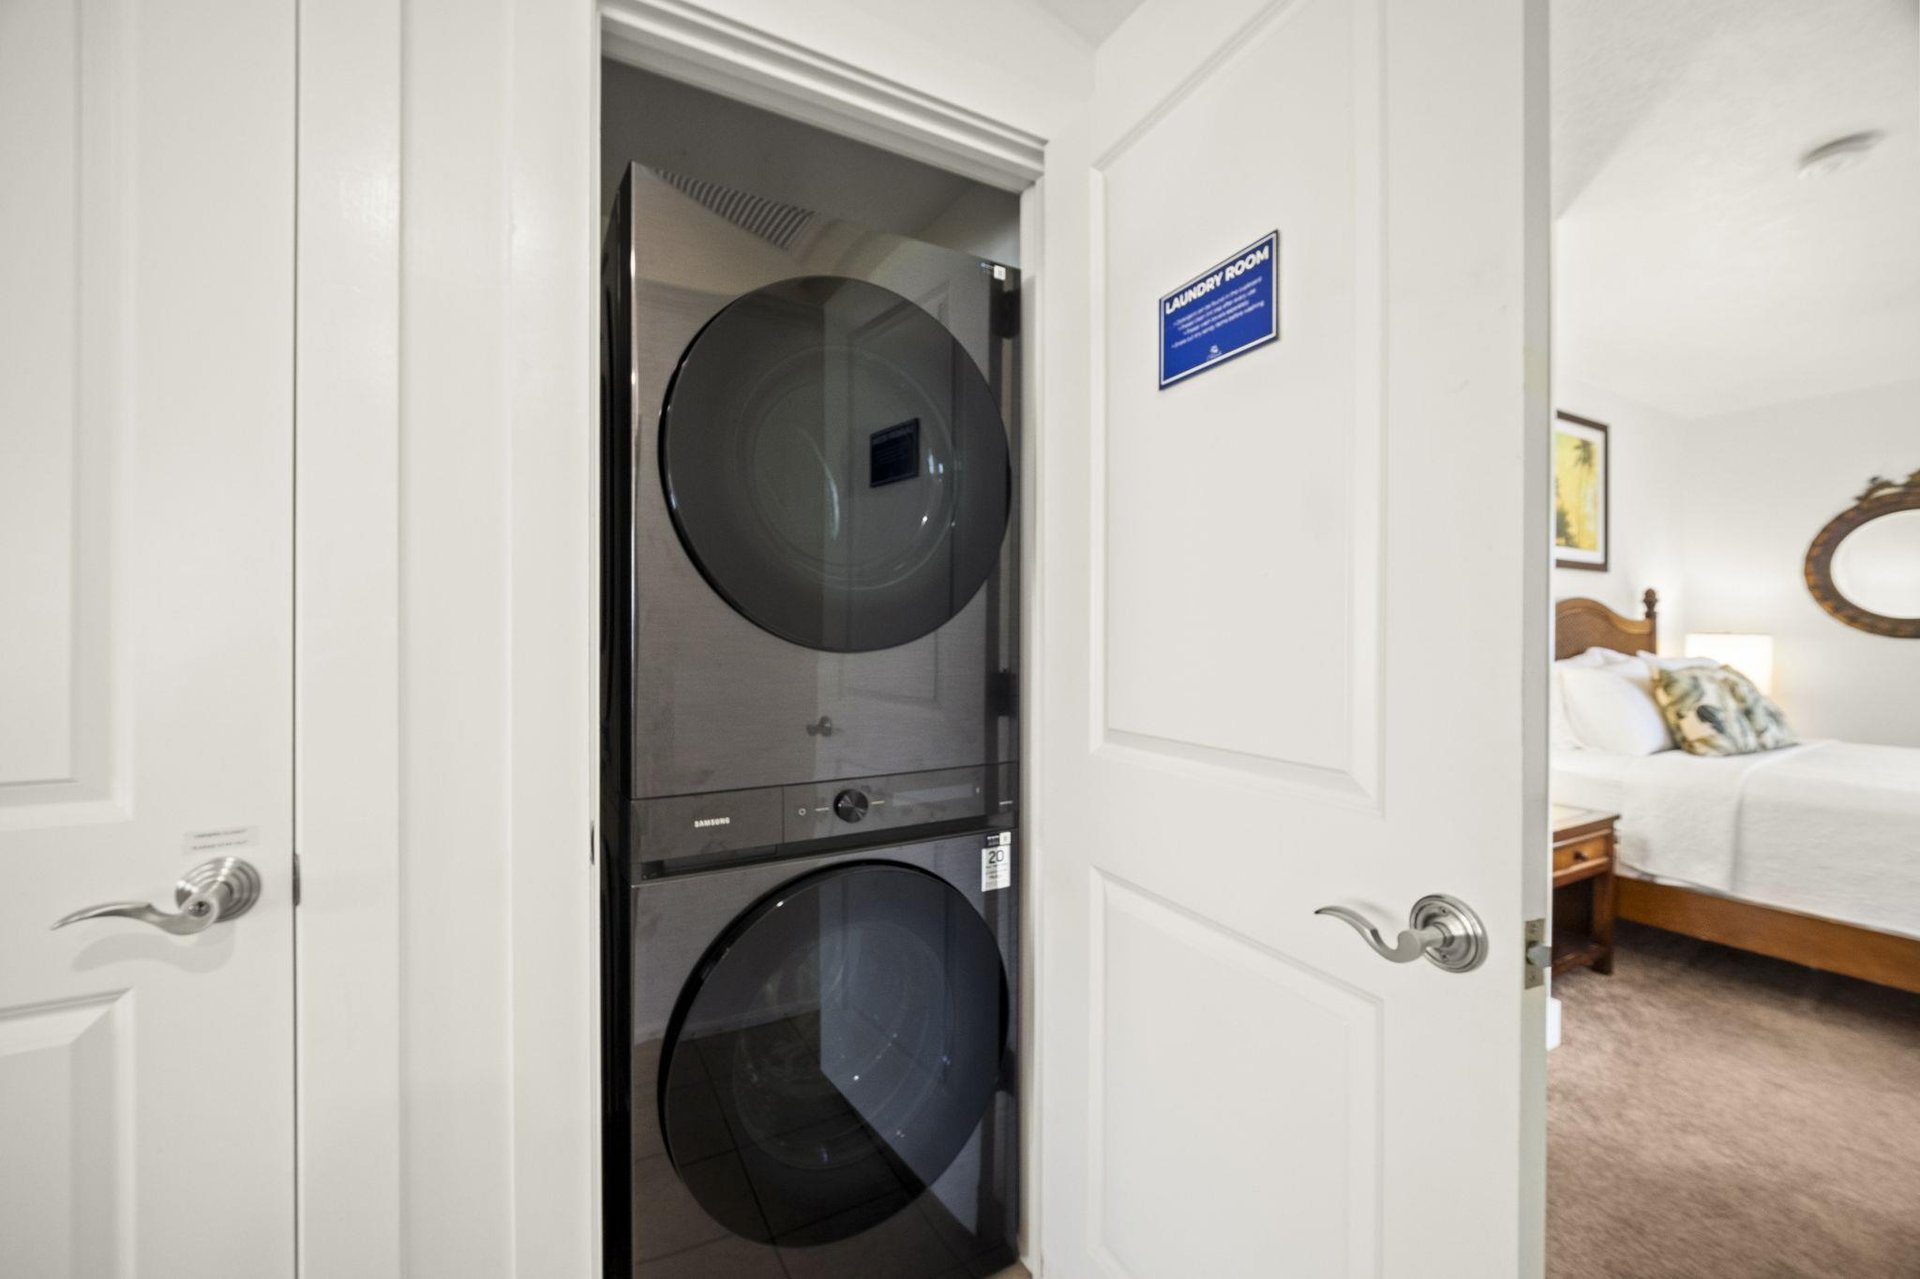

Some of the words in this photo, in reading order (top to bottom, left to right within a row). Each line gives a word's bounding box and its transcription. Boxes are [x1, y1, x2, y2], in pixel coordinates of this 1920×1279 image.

[1165, 271, 1223, 315] LAUNDRY
[1225, 245, 1270, 281] ROOM
[694, 816, 731, 828] SAMSUNG
[988, 849, 1005, 864] 20
